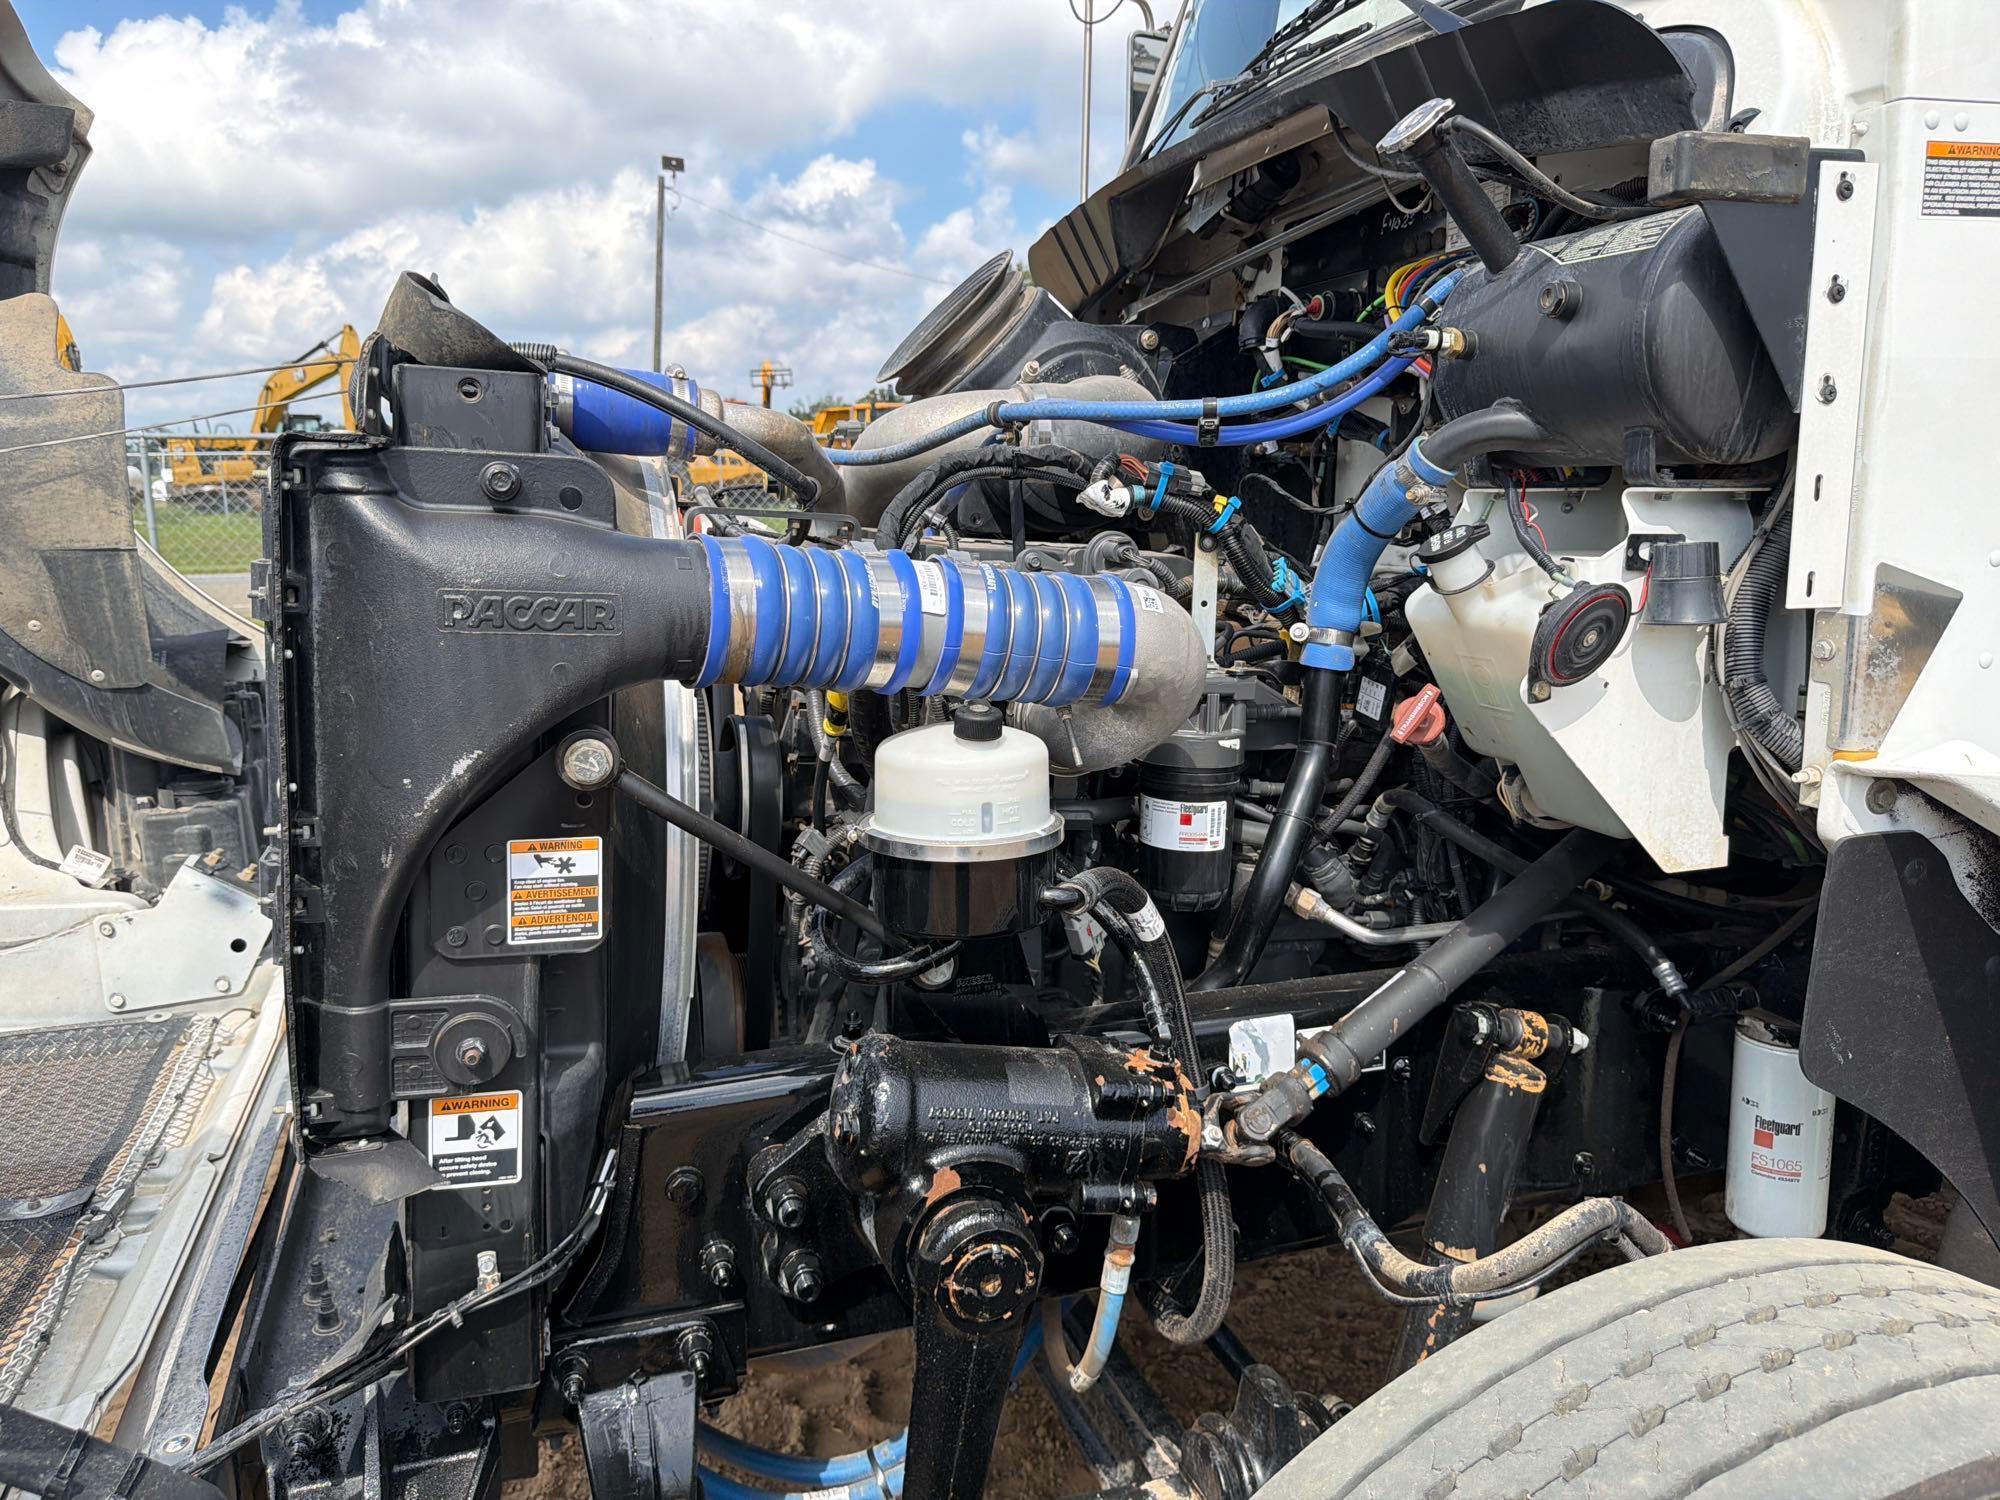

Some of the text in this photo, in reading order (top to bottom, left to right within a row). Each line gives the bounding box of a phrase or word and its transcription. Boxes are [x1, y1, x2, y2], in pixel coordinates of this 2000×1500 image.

[443, 595, 616, 631] PACCAR
[1400, 693, 1430, 731] TRANSMISSION
[539, 841, 583, 851] WARNING
[526, 887, 596, 899] AVERTISSEMENT
[531, 913, 593, 925] ADVERTENCIA
[452, 1097, 510, 1110] WARNING
[1755, 1115, 1800, 1136] Fleetguard
[1751, 1152, 1802, 1171] FS1065
[446, 1170, 468, 1178] prevent
